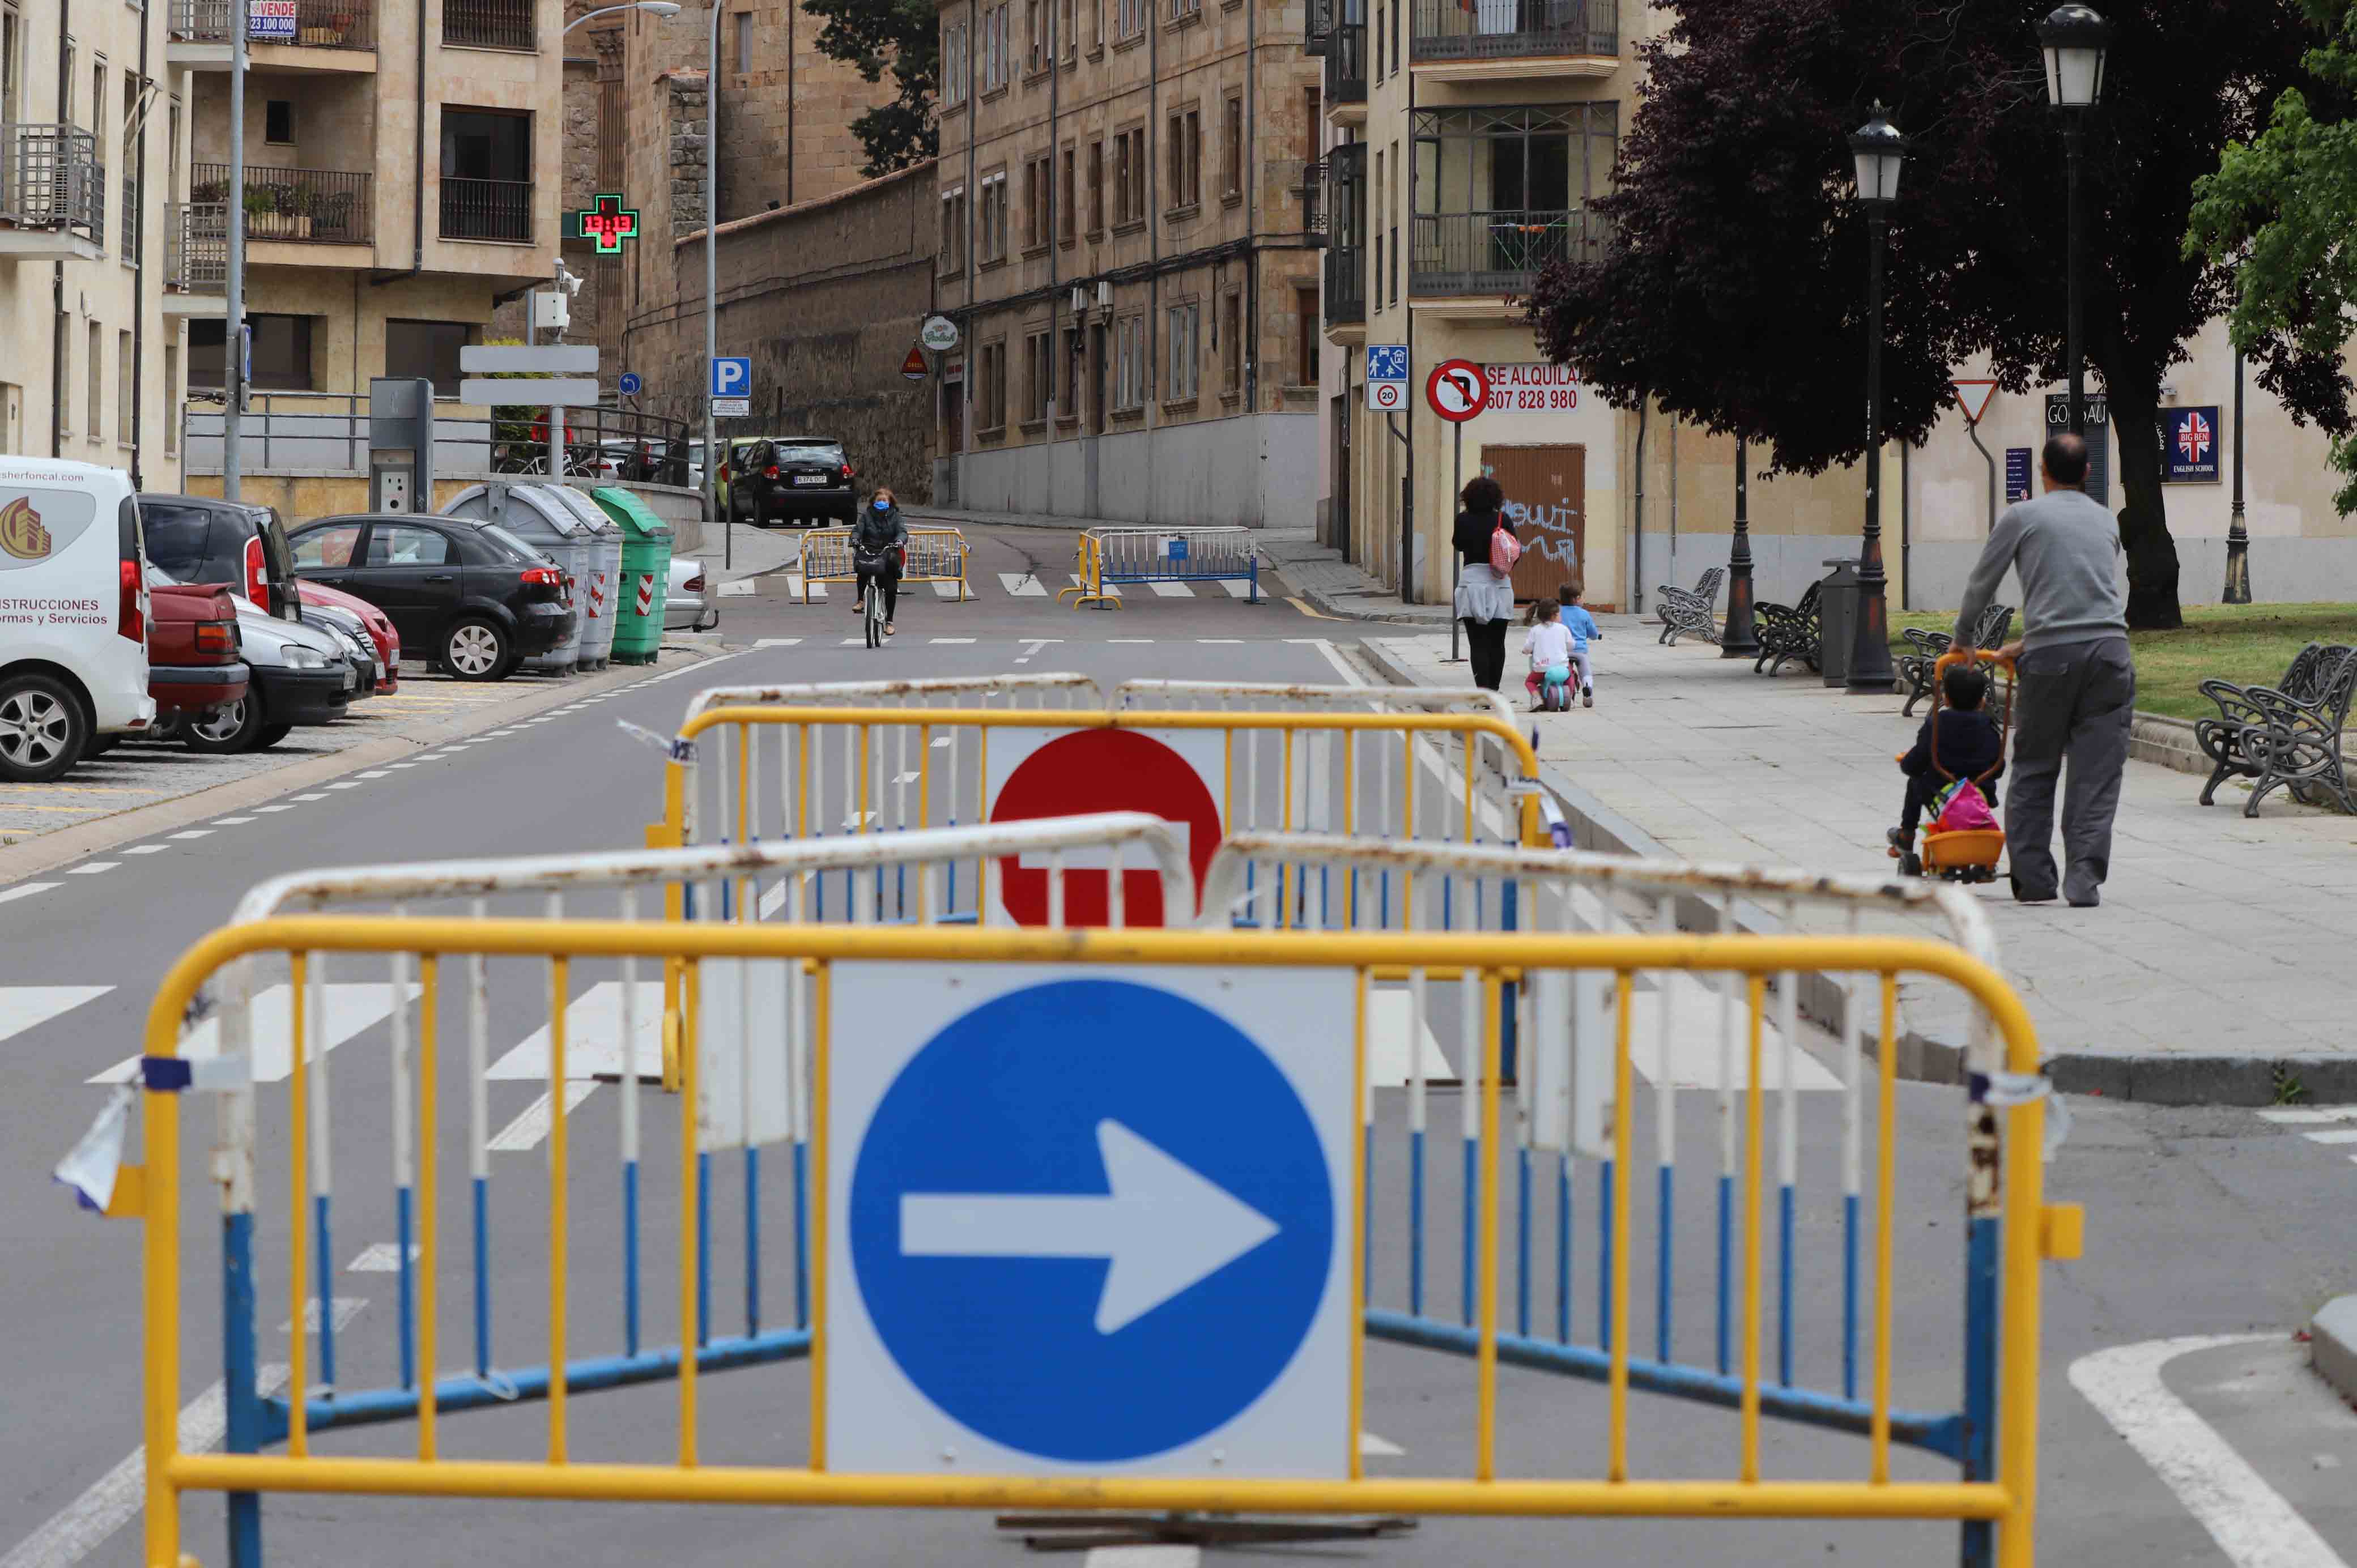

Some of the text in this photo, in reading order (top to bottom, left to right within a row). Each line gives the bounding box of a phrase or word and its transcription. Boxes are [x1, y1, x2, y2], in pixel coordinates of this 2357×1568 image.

[261, 2, 294, 16] VENDE
[262, 18, 278, 30] 100
[278, 18, 293, 30] 000
[585, 216, 631, 232] 13:13
[718, 361, 742, 393] P
[1487, 366, 1577, 386] SE ALQUILA
[1487, 390, 1577, 409] 607 828 980
[2181, 433, 2193, 441] BIG
[0, 471, 84, 482] sherfoncal.com
[0, 599, 99, 611] STRUCCIONES
[38, 616, 44, 626] y
[49, 613, 107, 624] Servicios
